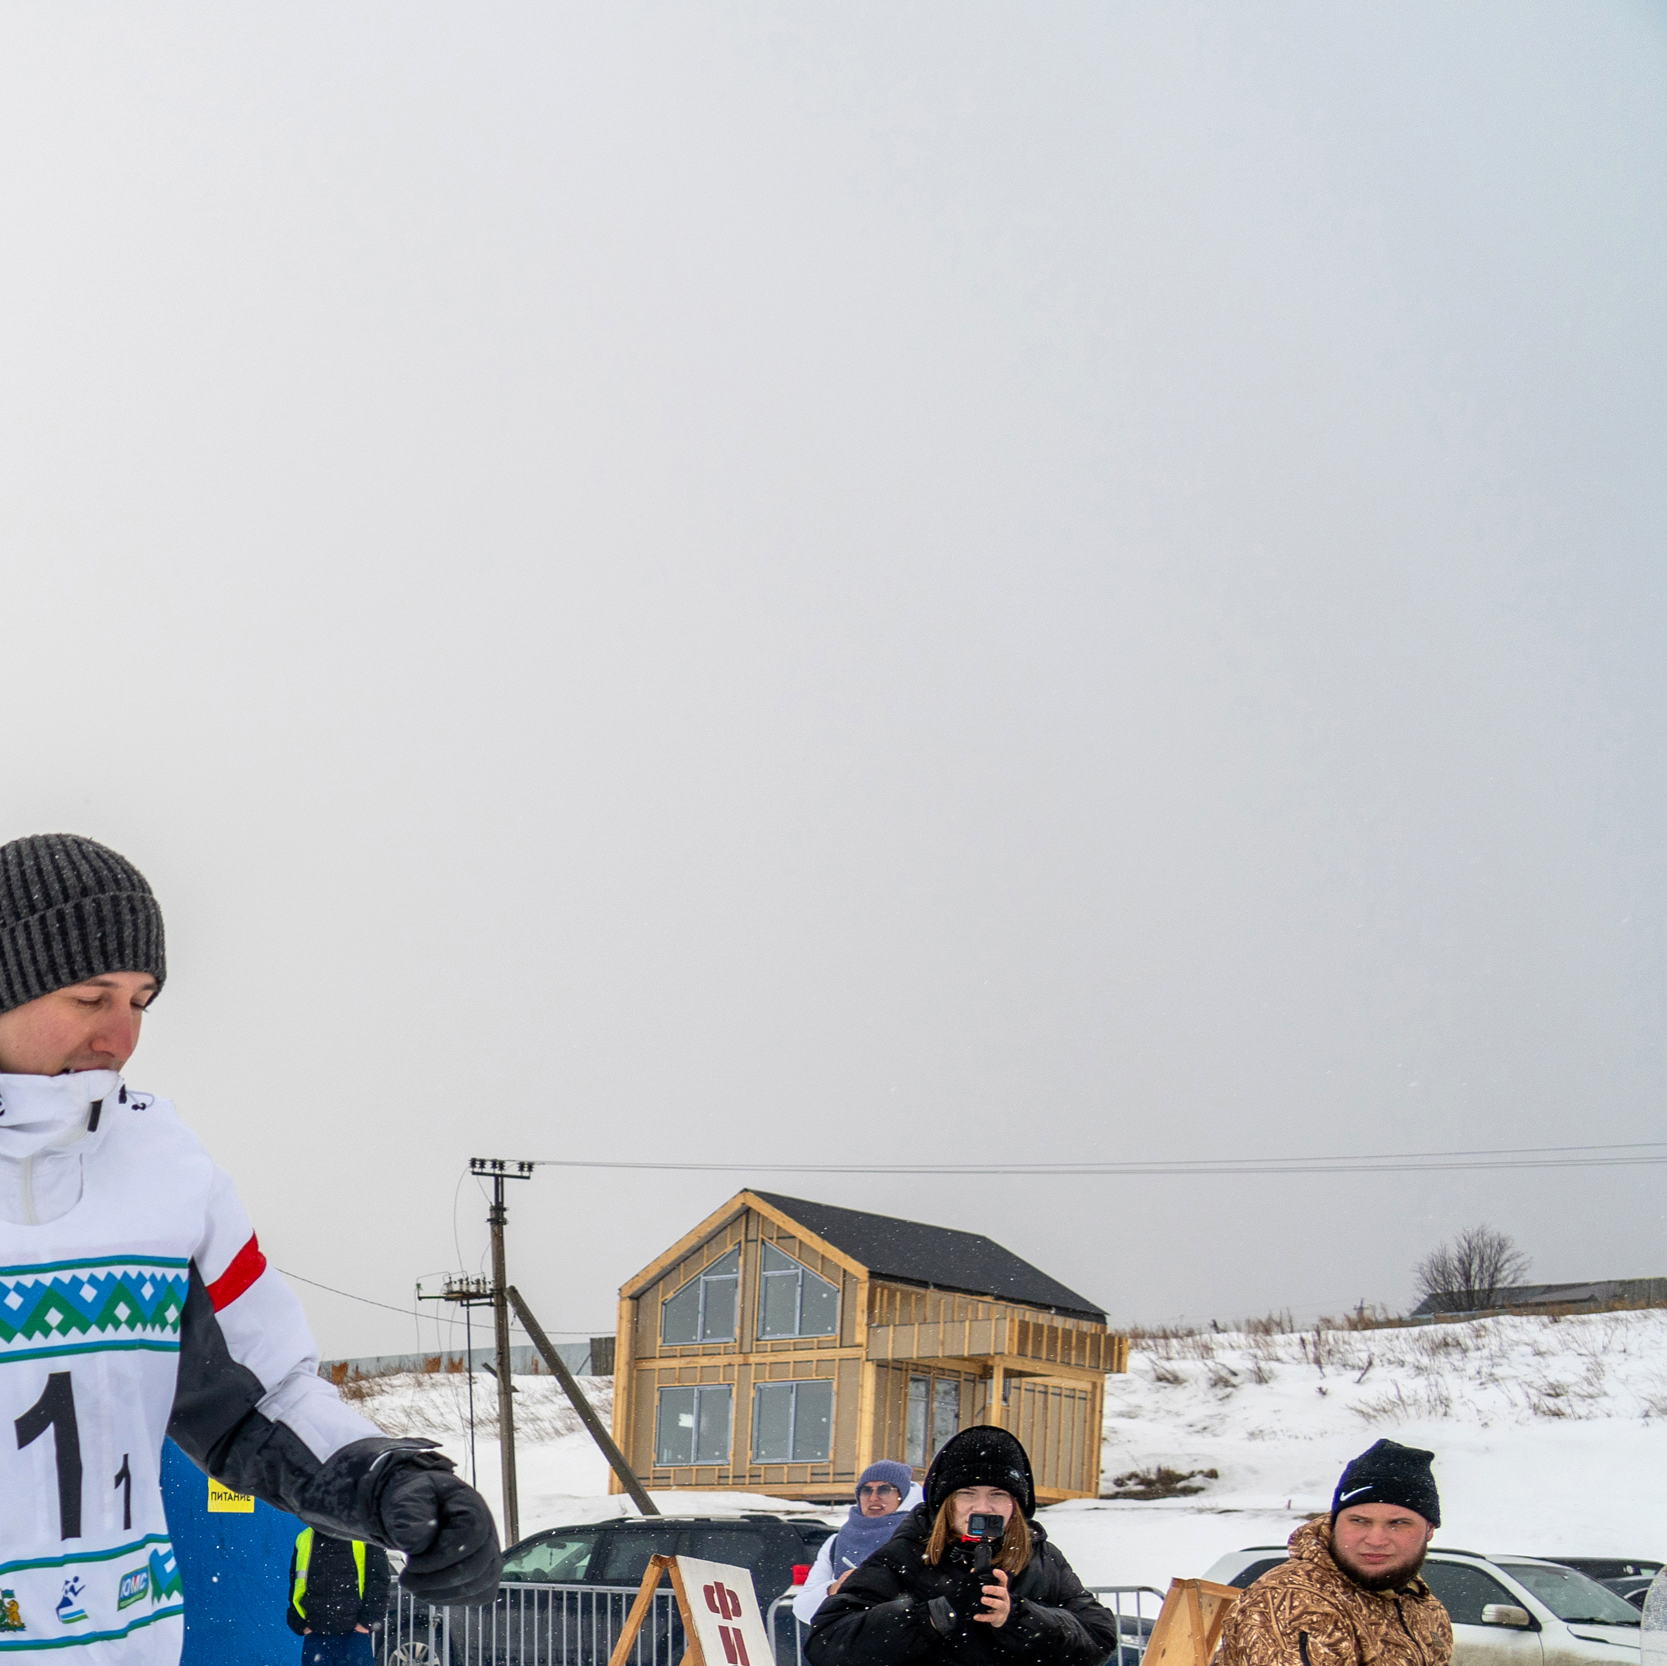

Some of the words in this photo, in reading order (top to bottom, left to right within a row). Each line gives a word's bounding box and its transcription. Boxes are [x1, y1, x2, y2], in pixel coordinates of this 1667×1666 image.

[14, 1371, 83, 1541] 1
[114, 1453, 131, 1530] 1
[210, 1491, 252, 1502] ПИТАНИЕ
